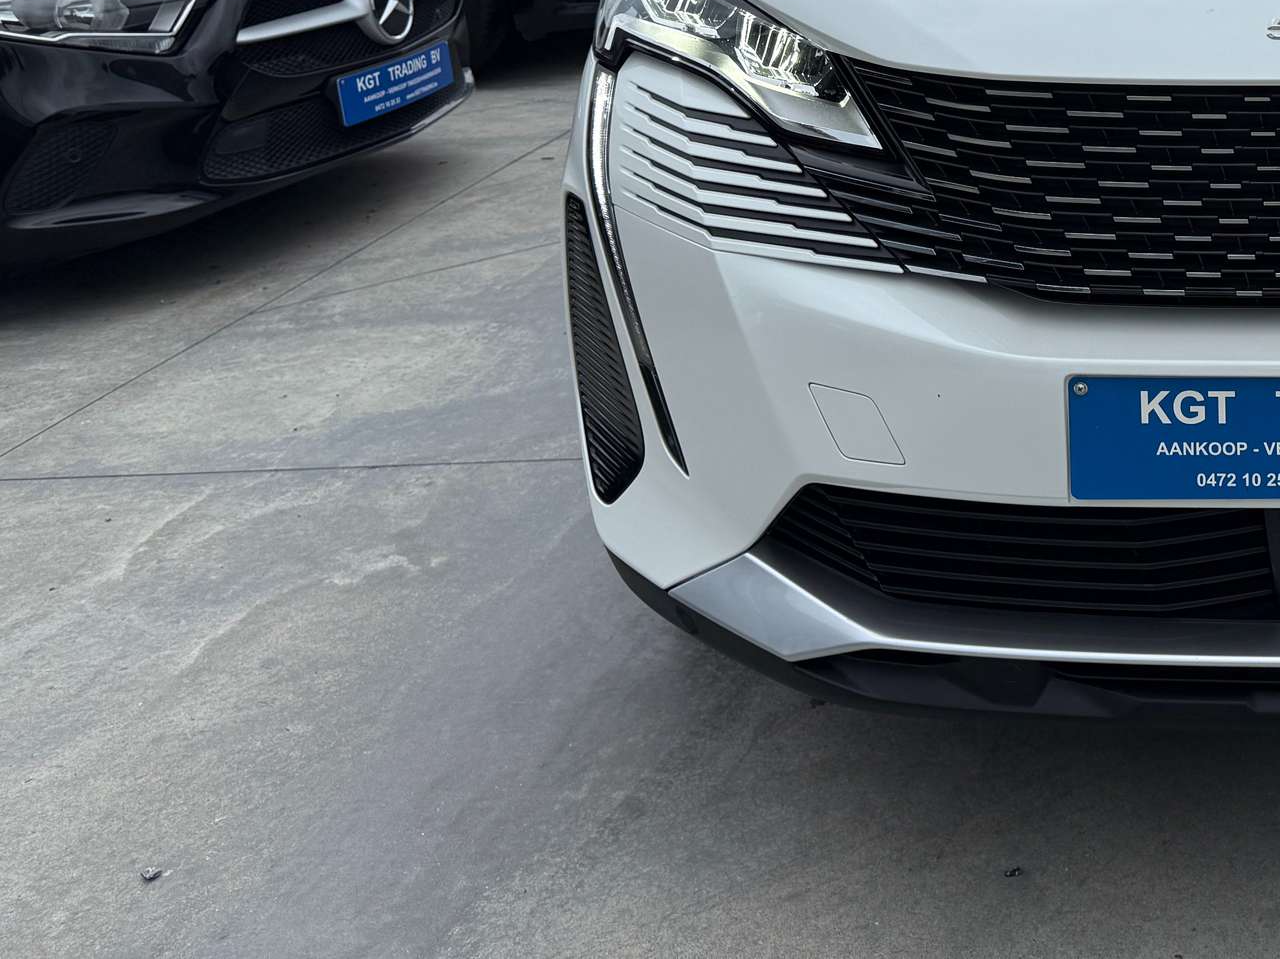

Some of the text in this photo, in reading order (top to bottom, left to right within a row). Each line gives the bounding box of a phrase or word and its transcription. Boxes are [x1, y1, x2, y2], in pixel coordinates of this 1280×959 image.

[356, 72, 380, 92] KGT
[387, 54, 427, 81] TRADING
[430, 47, 441, 64] BV
[1139, 390, 1236, 425] KGT
[1156, 441, 1248, 456] AANKOOP
[1196, 473, 1237, 487] 0472
[1242, 473, 1261, 487] 10
